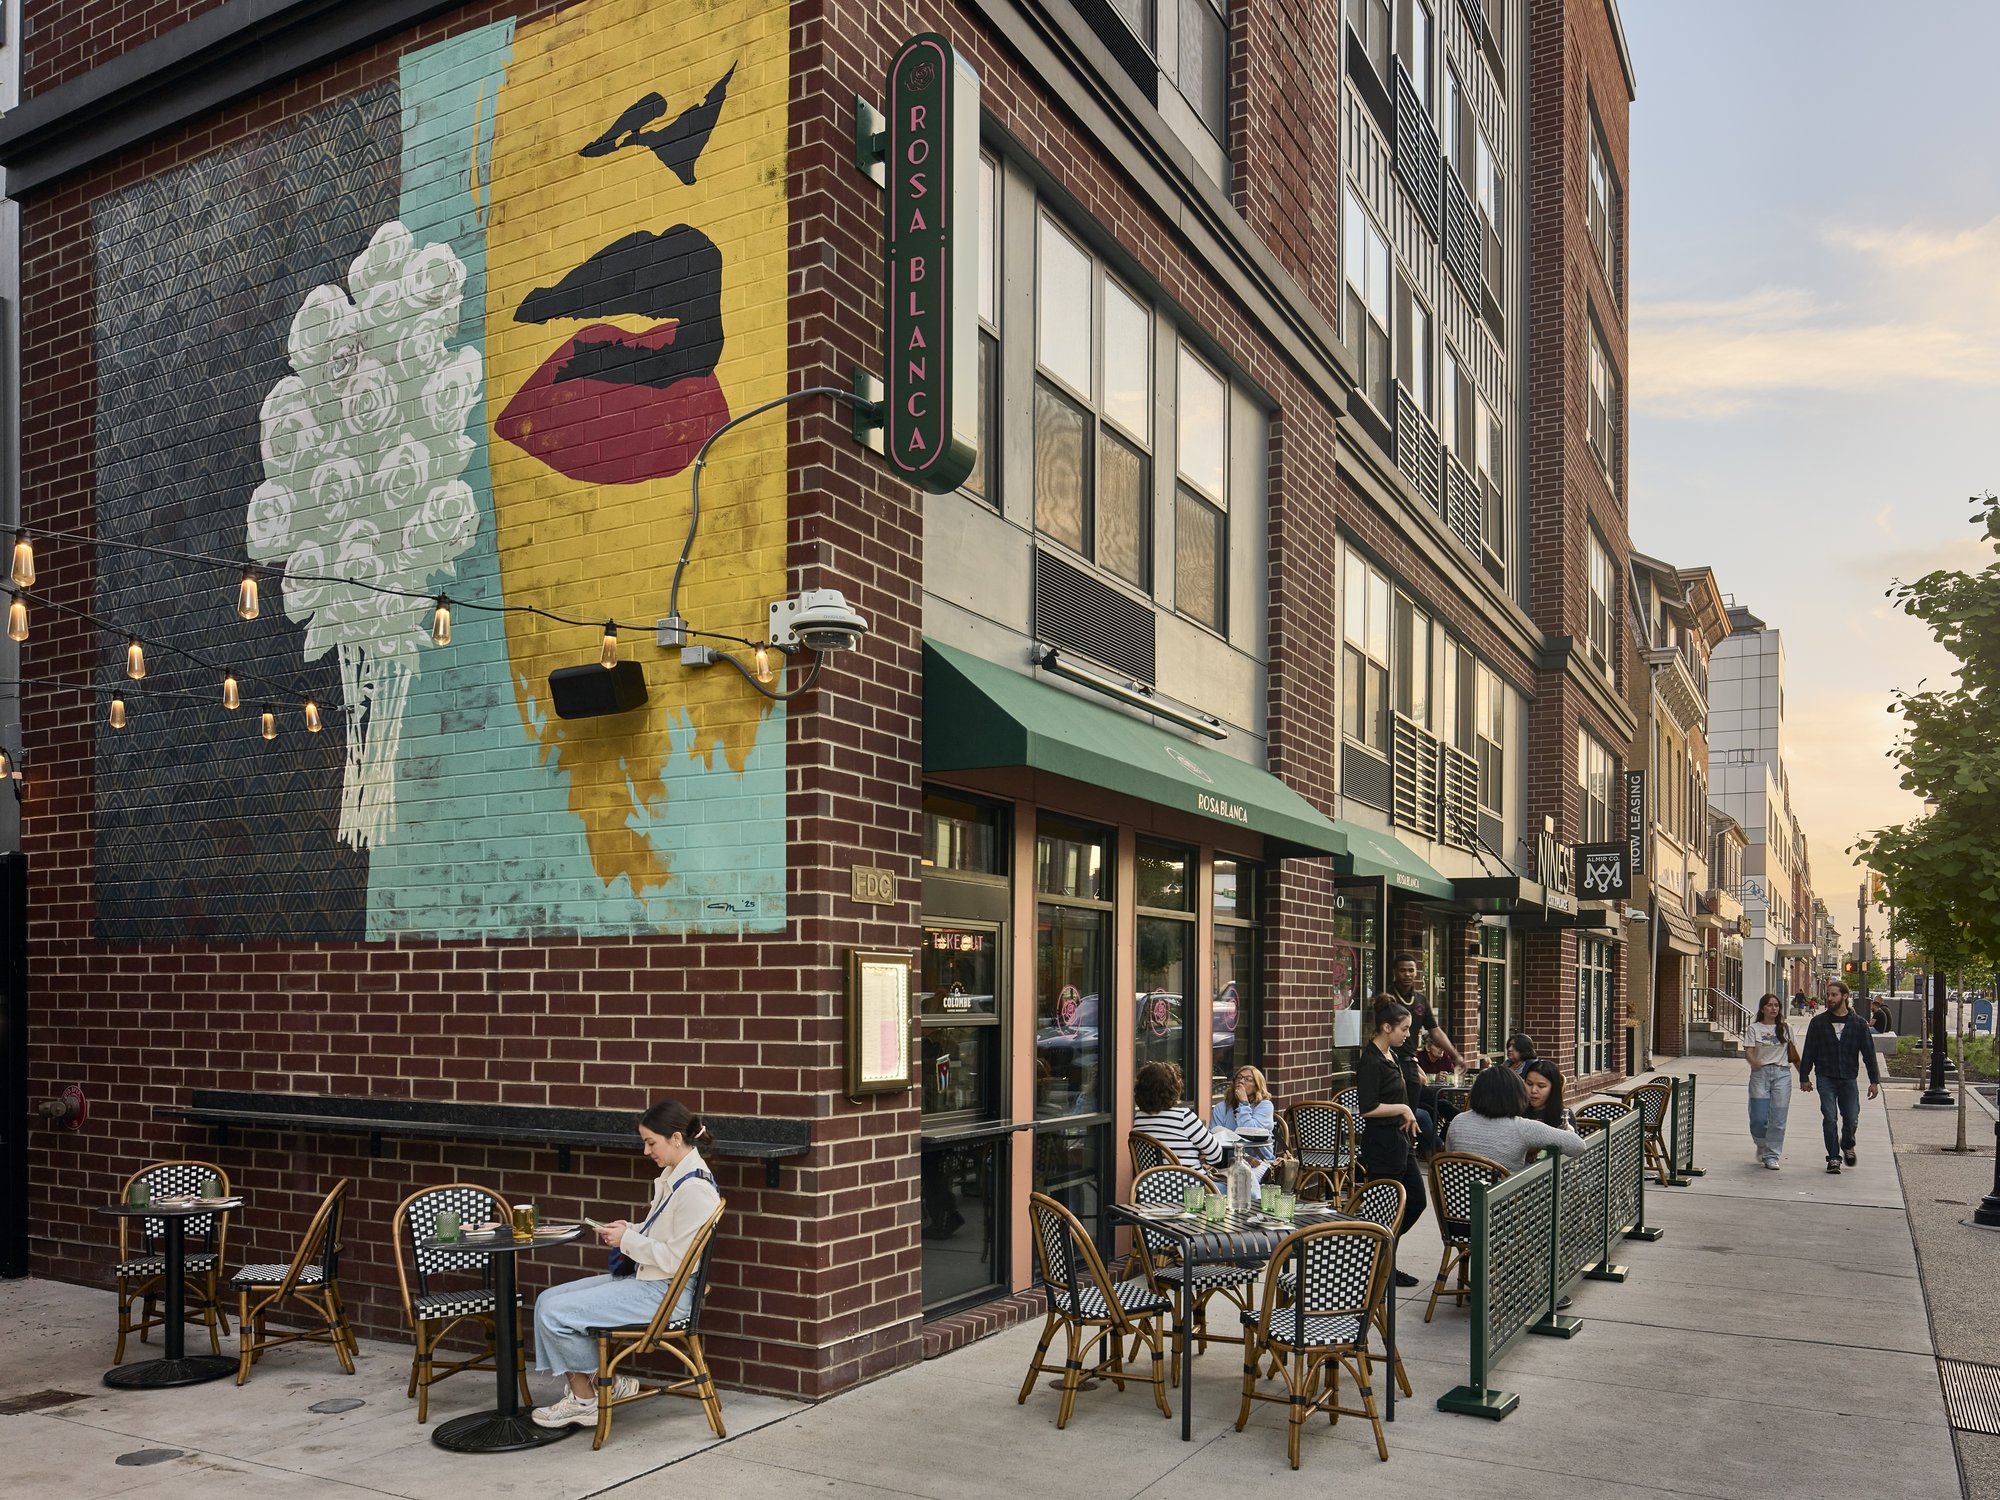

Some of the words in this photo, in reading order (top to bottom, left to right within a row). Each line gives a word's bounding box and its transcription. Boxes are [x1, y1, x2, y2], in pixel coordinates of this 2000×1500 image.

[907, 105, 930, 234] ROSA
[907, 256, 927, 452] BLANCA
[1198, 793, 1220, 815] ROSA
[1220, 800, 1248, 823] BLANCA
[1631, 775, 1641, 830] LEASING
[1631, 834, 1641, 867] NOW
[855, 871, 892, 898] FDC
[932, 932, 984, 951] TAKEOUT
[943, 997, 971, 1008] COLOMBE
